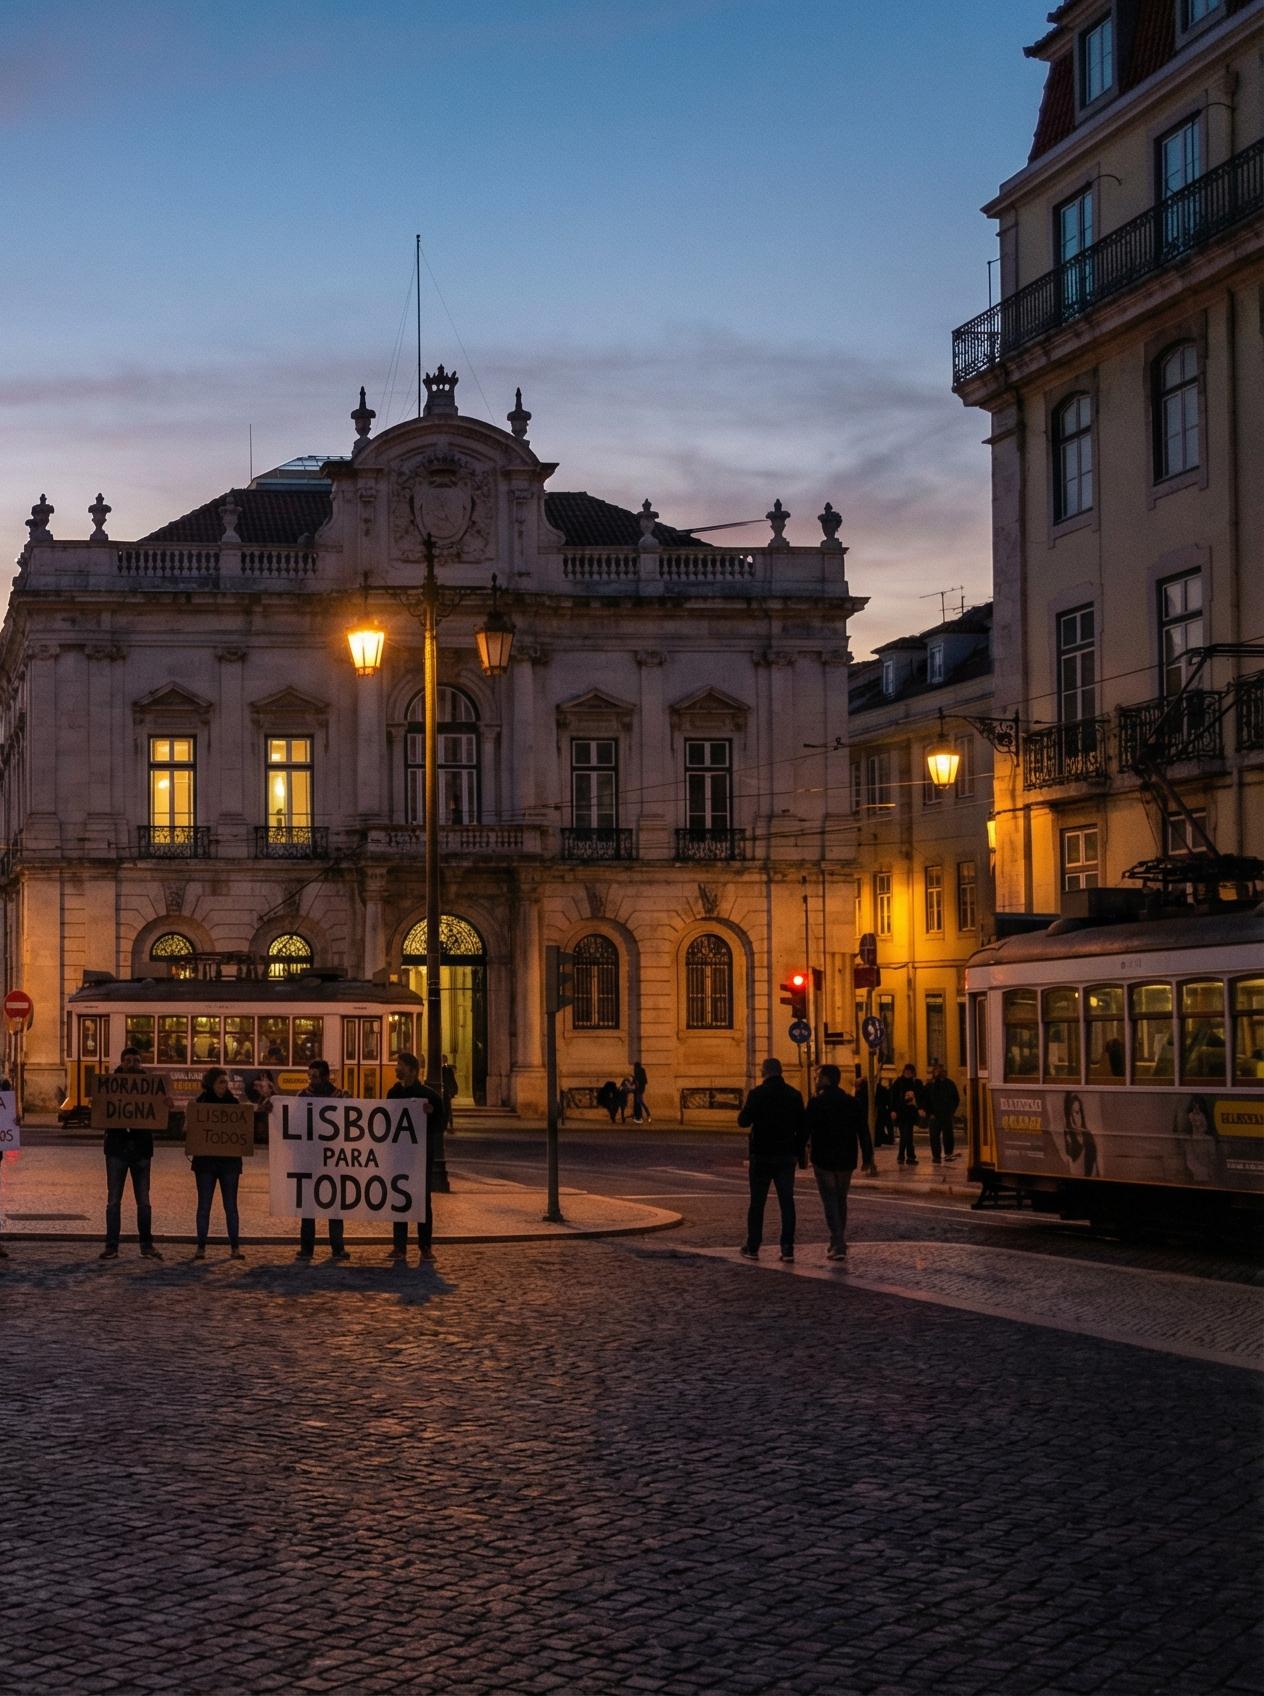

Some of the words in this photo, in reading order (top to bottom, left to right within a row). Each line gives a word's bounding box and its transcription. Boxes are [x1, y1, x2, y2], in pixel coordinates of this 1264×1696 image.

[97, 1076, 167, 1096] MORADIA
[106, 1099, 157, 1120] DIGNA
[282, 1103, 418, 1144] LISBOA
[323, 1147, 380, 1168] PARA
[287, 1172, 413, 1213] TODOS
